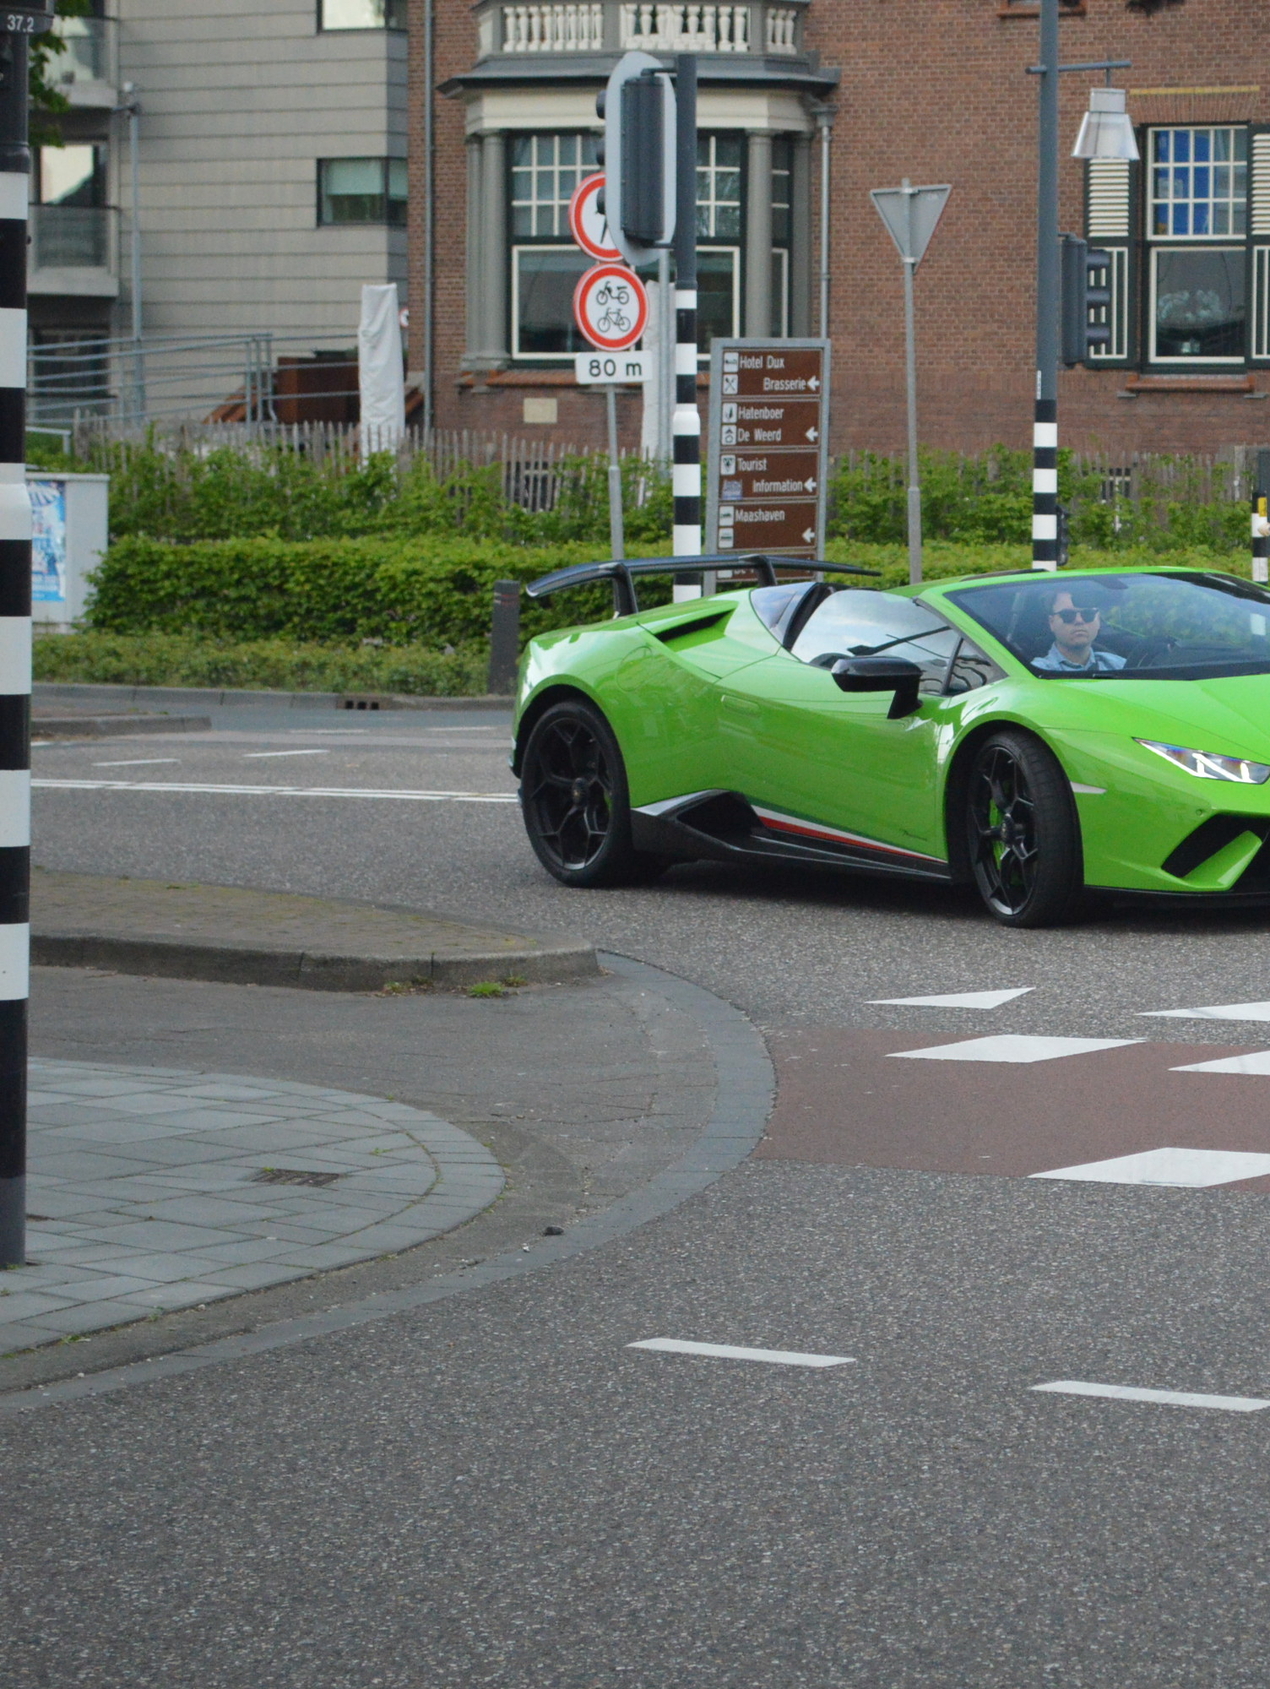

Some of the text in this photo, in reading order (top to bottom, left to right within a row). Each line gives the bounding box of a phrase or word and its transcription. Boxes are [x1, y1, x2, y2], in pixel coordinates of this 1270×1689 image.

[7, 14, 35, 33] 37.2
[589, 359, 642, 377] 80 m
[740, 355, 785, 369] Hotel Dux
[763, 377, 806, 391] Brasserie
[738, 406, 784, 420] Hatenboer
[738, 428, 782, 442] De Weerd
[737, 458, 767, 471] Tourist
[753, 479, 803, 493] Information
[735, 509, 785, 522] Maashaven
